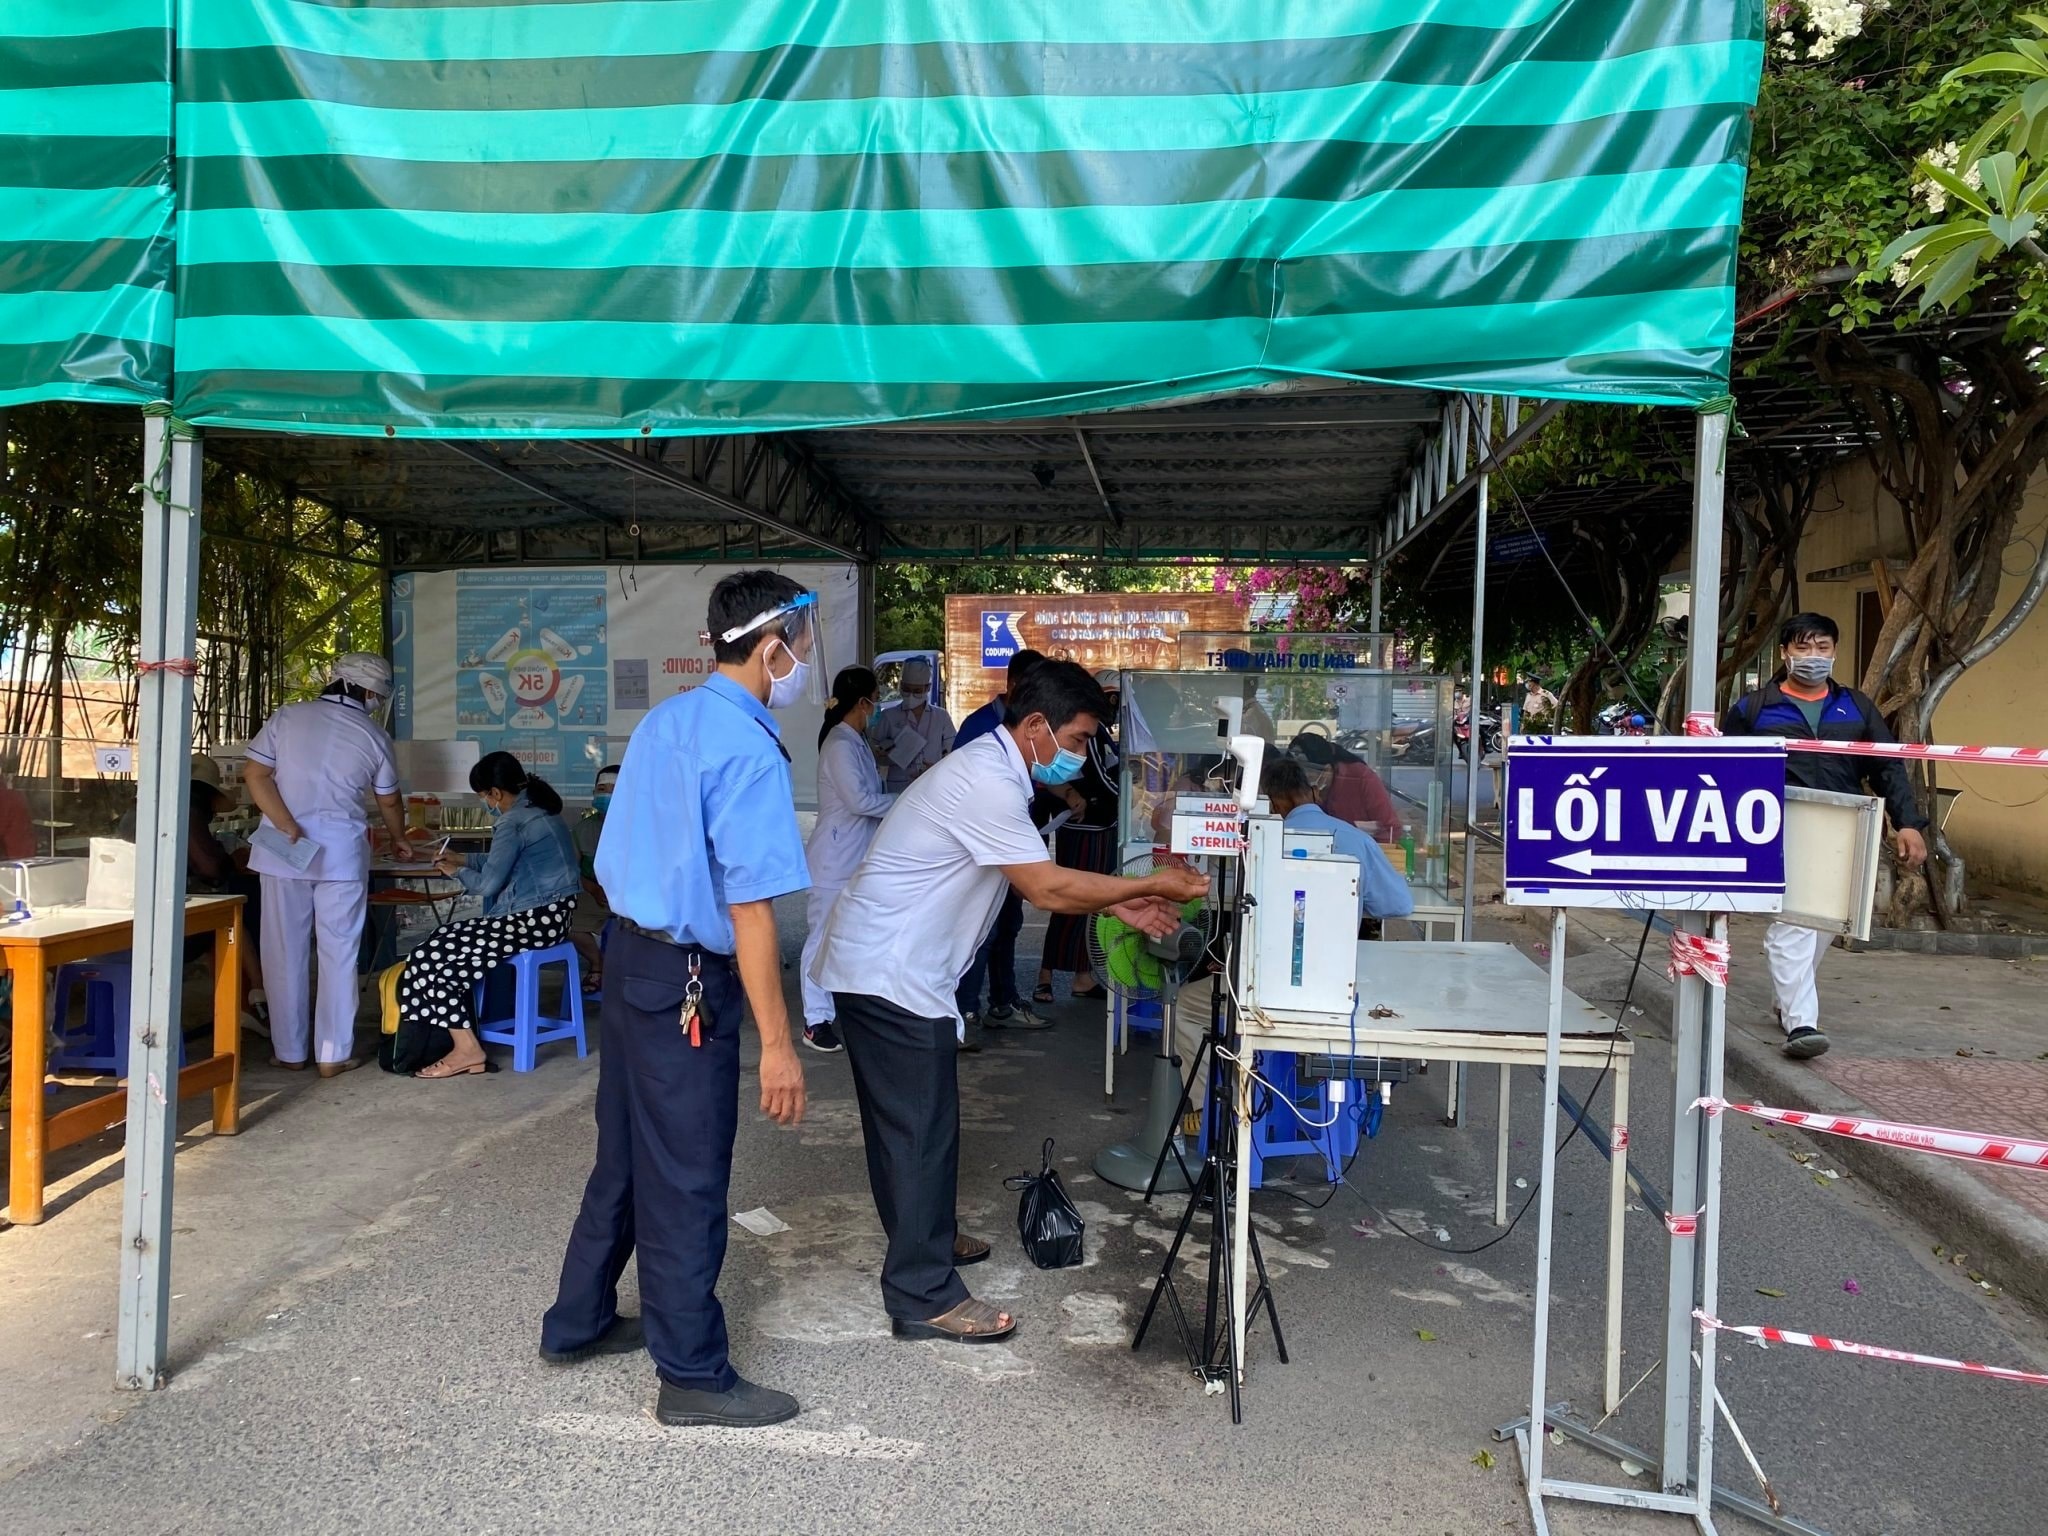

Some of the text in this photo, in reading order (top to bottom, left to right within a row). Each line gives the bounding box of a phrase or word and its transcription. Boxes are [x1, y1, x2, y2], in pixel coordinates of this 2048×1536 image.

[985, 648, 1014, 657] CODUPHA
[1047, 643, 1172, 665] CODUPHA
[1205, 803, 1238, 813] HAND
[1518, 767, 1781, 845] LỐI VÀO
[1876, 1128, 1890, 1139] KHU
[1921, 1135, 1935, 1145] VÀO
